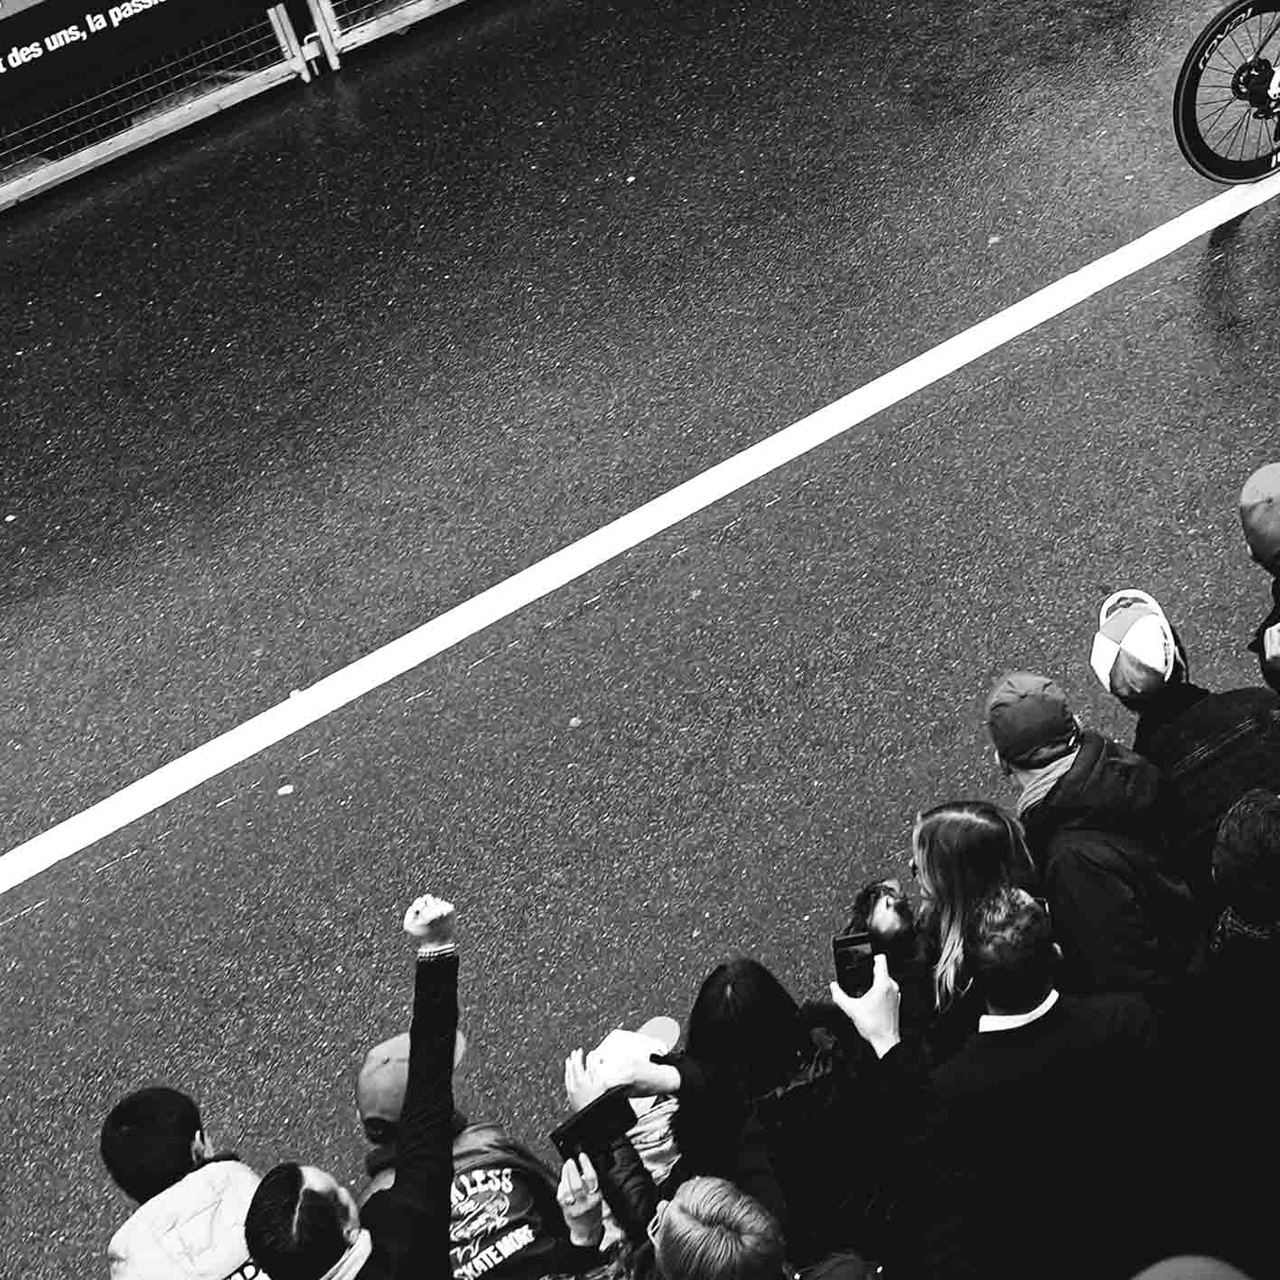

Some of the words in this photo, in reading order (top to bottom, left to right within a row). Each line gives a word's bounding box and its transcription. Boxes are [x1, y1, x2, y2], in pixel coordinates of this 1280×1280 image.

[7, 41, 43, 69] des
[45, 24, 87, 52] uns,
[86, 13, 107, 33] la
